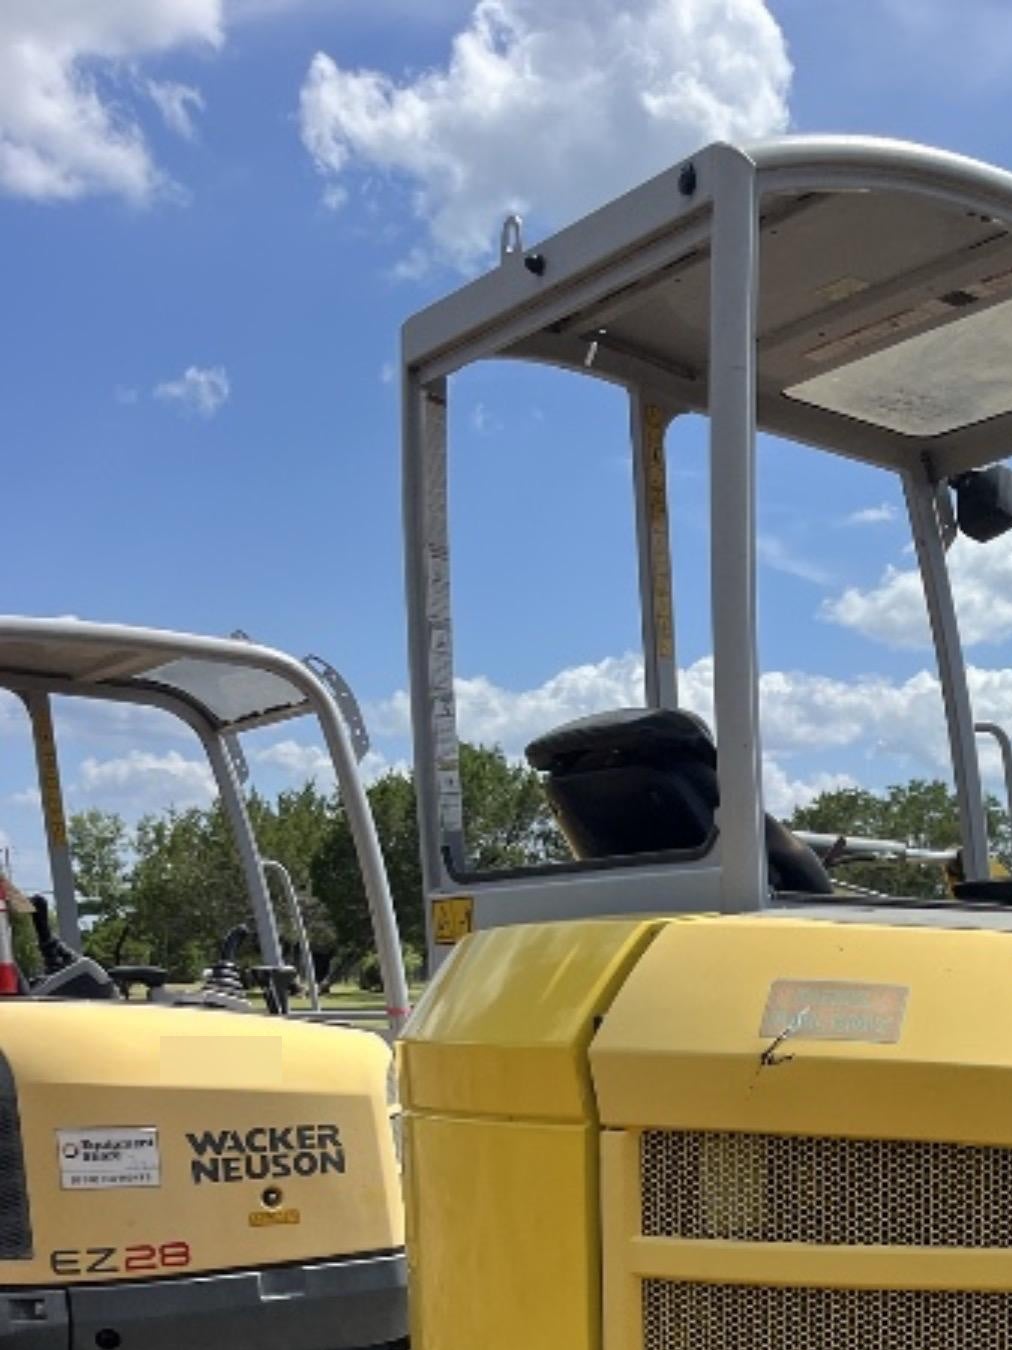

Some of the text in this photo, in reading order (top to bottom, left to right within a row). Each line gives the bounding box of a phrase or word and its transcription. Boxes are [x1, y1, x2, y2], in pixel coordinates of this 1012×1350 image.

[186, 1124, 342, 1156] WACKER
[191, 1151, 345, 1185] NEUSON
[51, 1241, 192, 1275] EZ28
